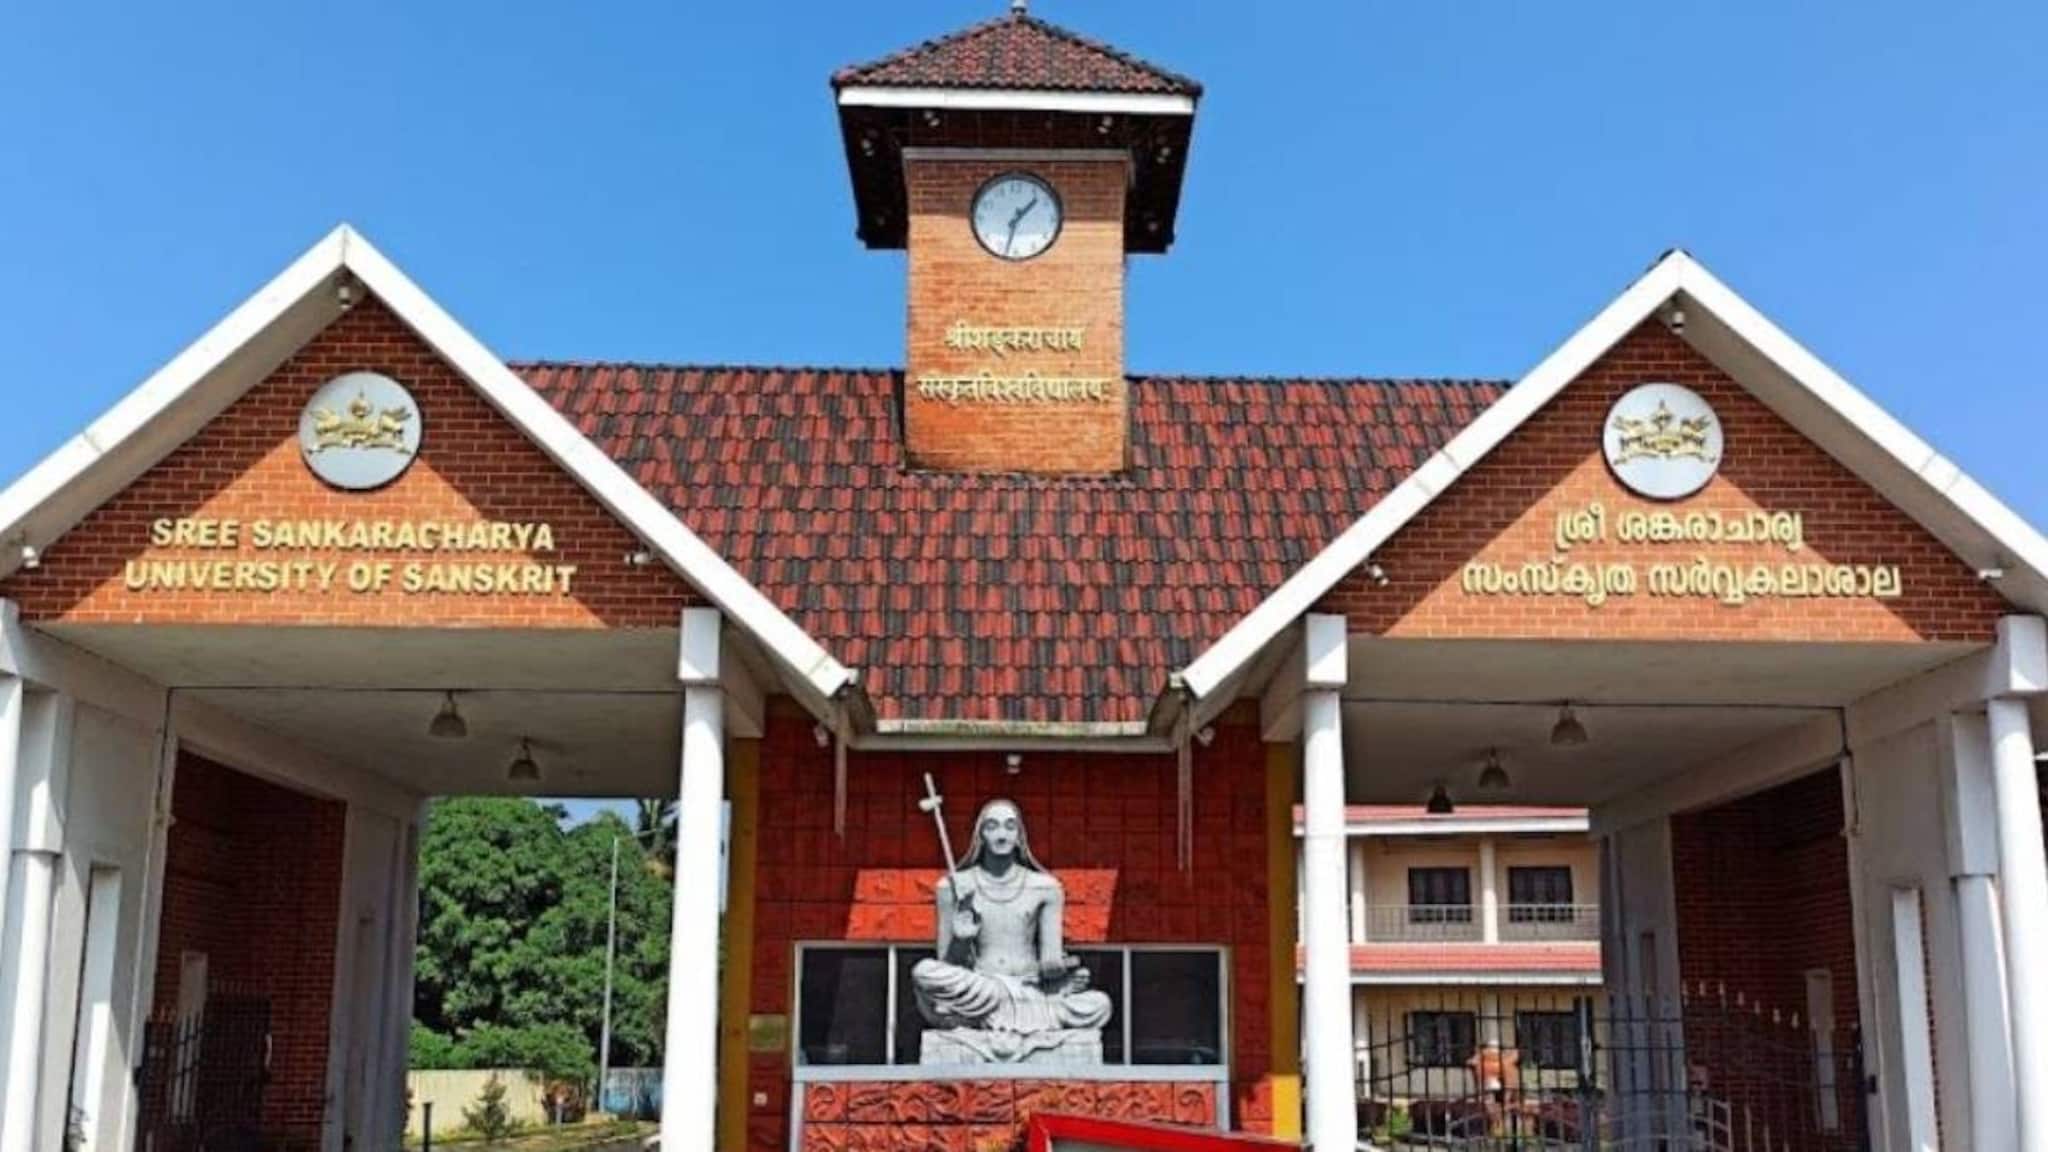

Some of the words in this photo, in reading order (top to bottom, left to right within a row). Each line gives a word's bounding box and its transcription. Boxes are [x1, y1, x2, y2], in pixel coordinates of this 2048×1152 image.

[151, 518, 239, 548] SREE
[252, 520, 555, 553] SANKARACHARYA
[1556, 502, 1605, 549] ശ്രീ
[1617, 511, 1803, 550] ശങ്കരാചാര്യ
[124, 561, 337, 591] UNIVERSITY
[348, 563, 391, 592] OF
[402, 564, 577, 595] SANSKRIT
